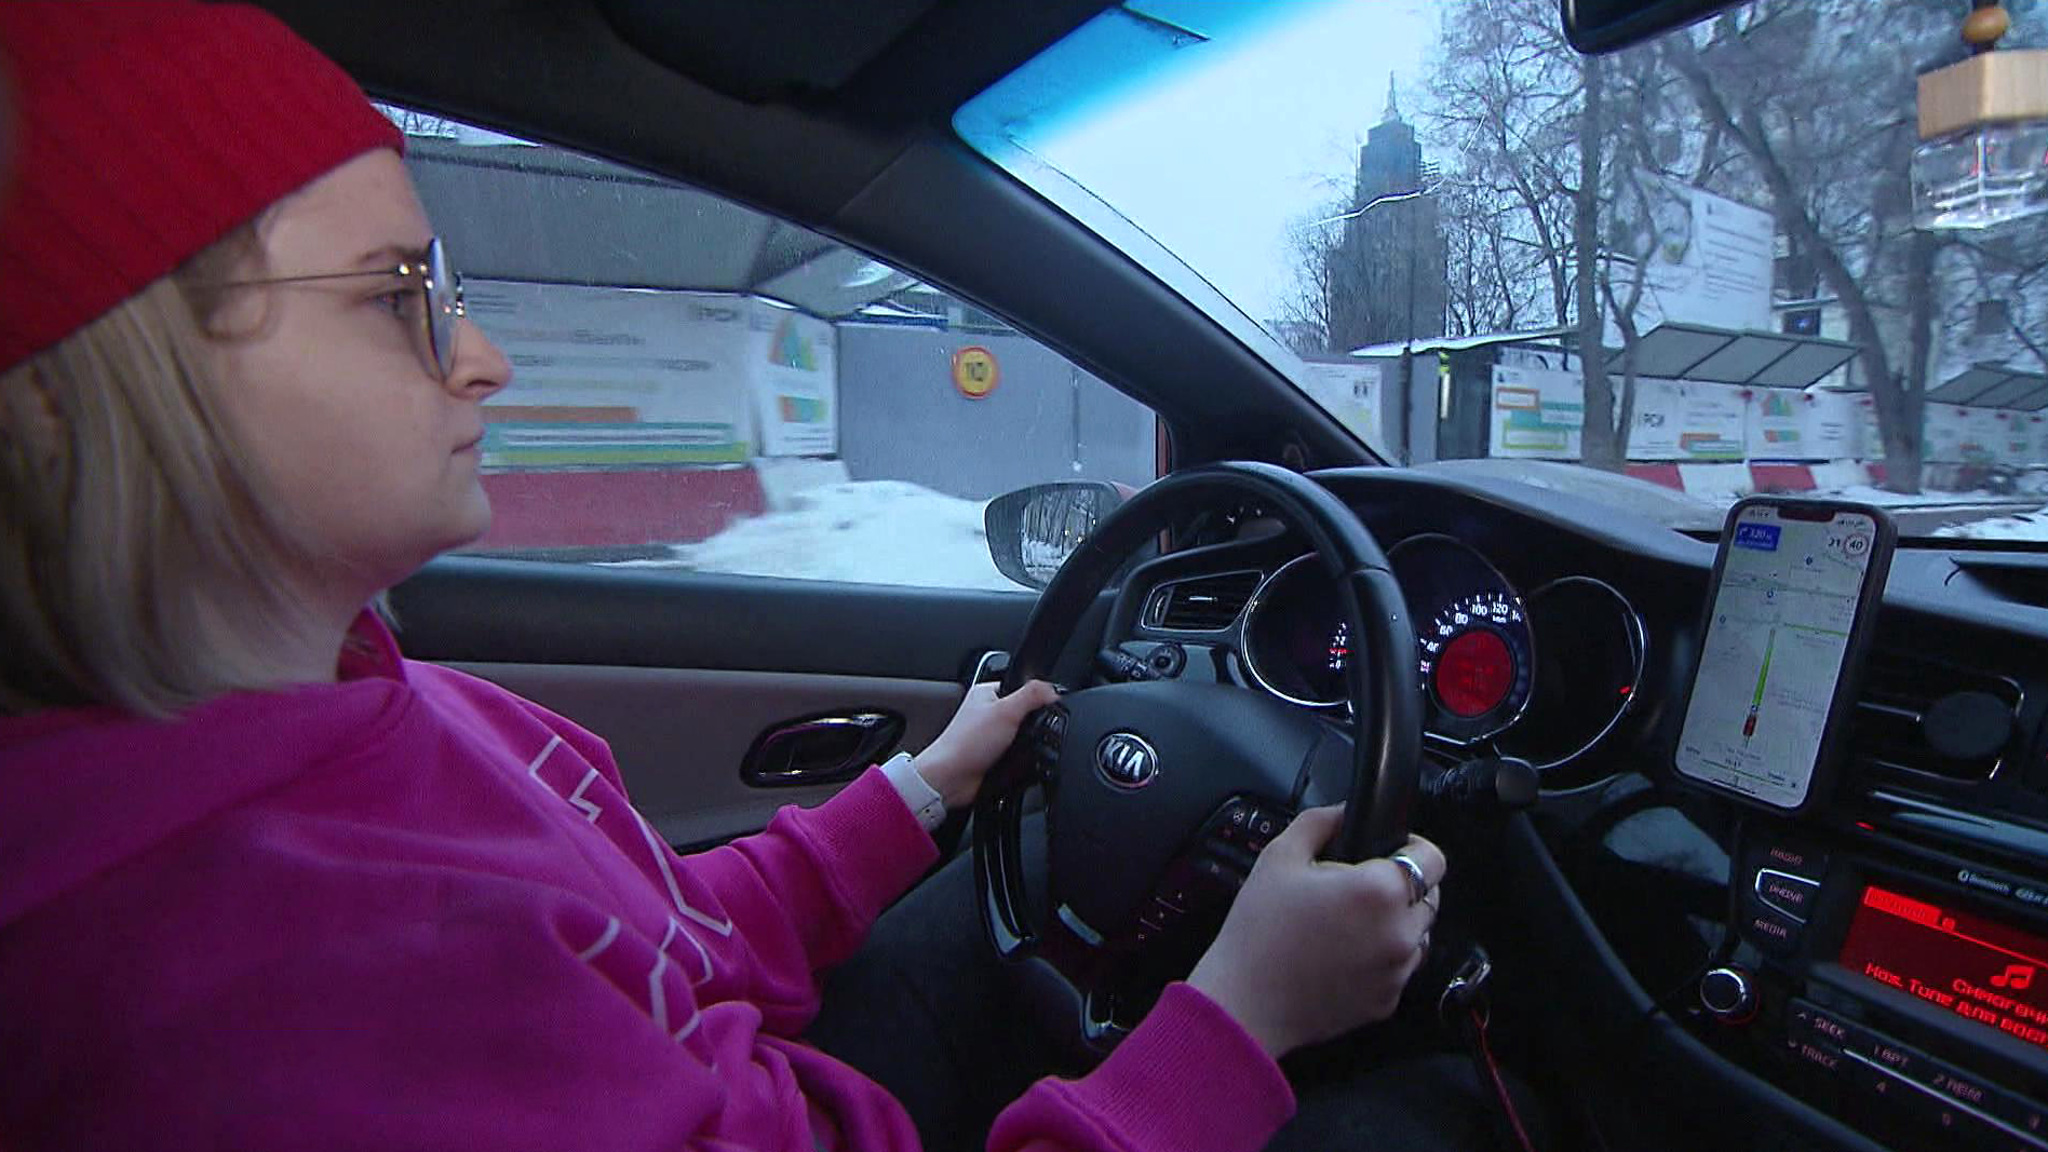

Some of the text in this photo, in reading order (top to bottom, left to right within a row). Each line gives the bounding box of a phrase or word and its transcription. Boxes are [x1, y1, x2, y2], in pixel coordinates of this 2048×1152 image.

[1849, 540, 1863, 550] 40
[1472, 604, 1488, 616] 100
[1493, 602, 1509, 615] 120
[1101, 737, 1145, 778] KIA
[1754, 918, 1788, 939] MEDIA
[1814, 1017, 1846, 1040] SEEK
